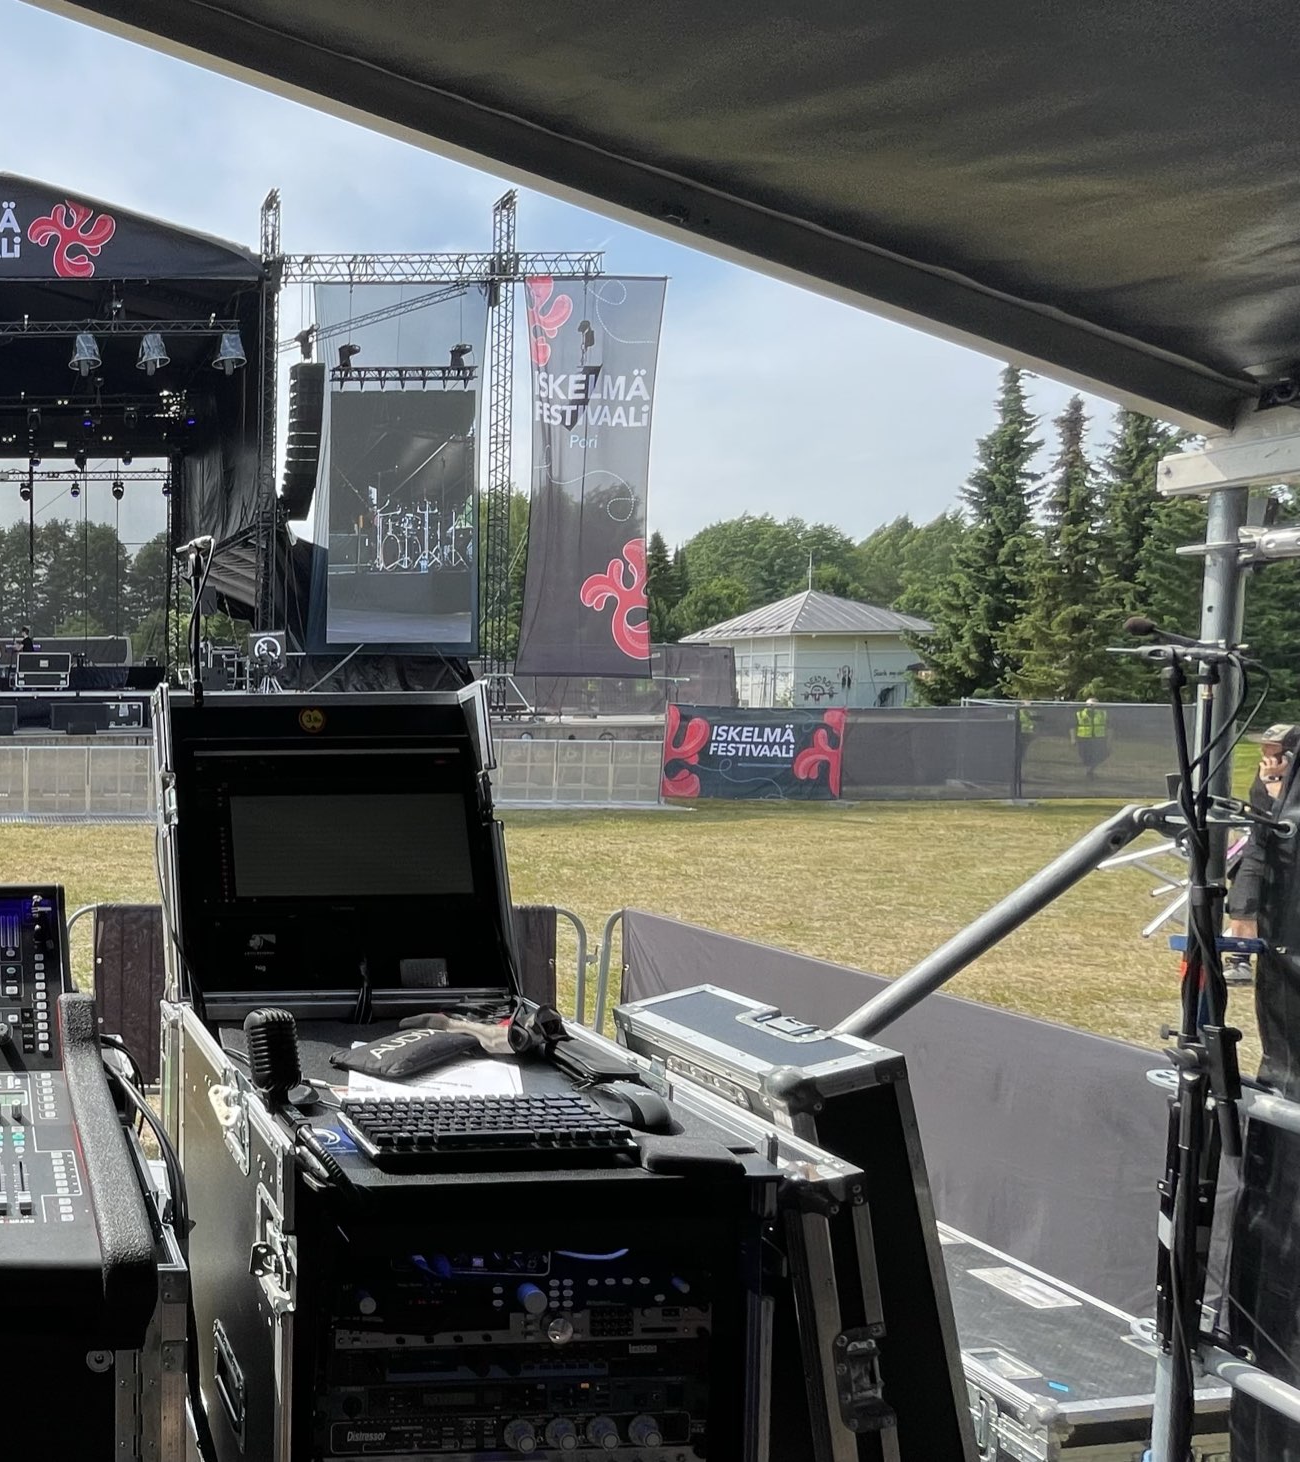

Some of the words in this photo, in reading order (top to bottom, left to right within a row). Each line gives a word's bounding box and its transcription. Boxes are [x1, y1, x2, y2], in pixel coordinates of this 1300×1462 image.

[534, 369, 651, 401] ISKELMÄ
[569, 434, 598, 449] Pori
[711, 724, 795, 743] ISKELMÄ
[370, 1029, 446, 1060] AUDIX
[347, 1430, 387, 1443] Distressor
